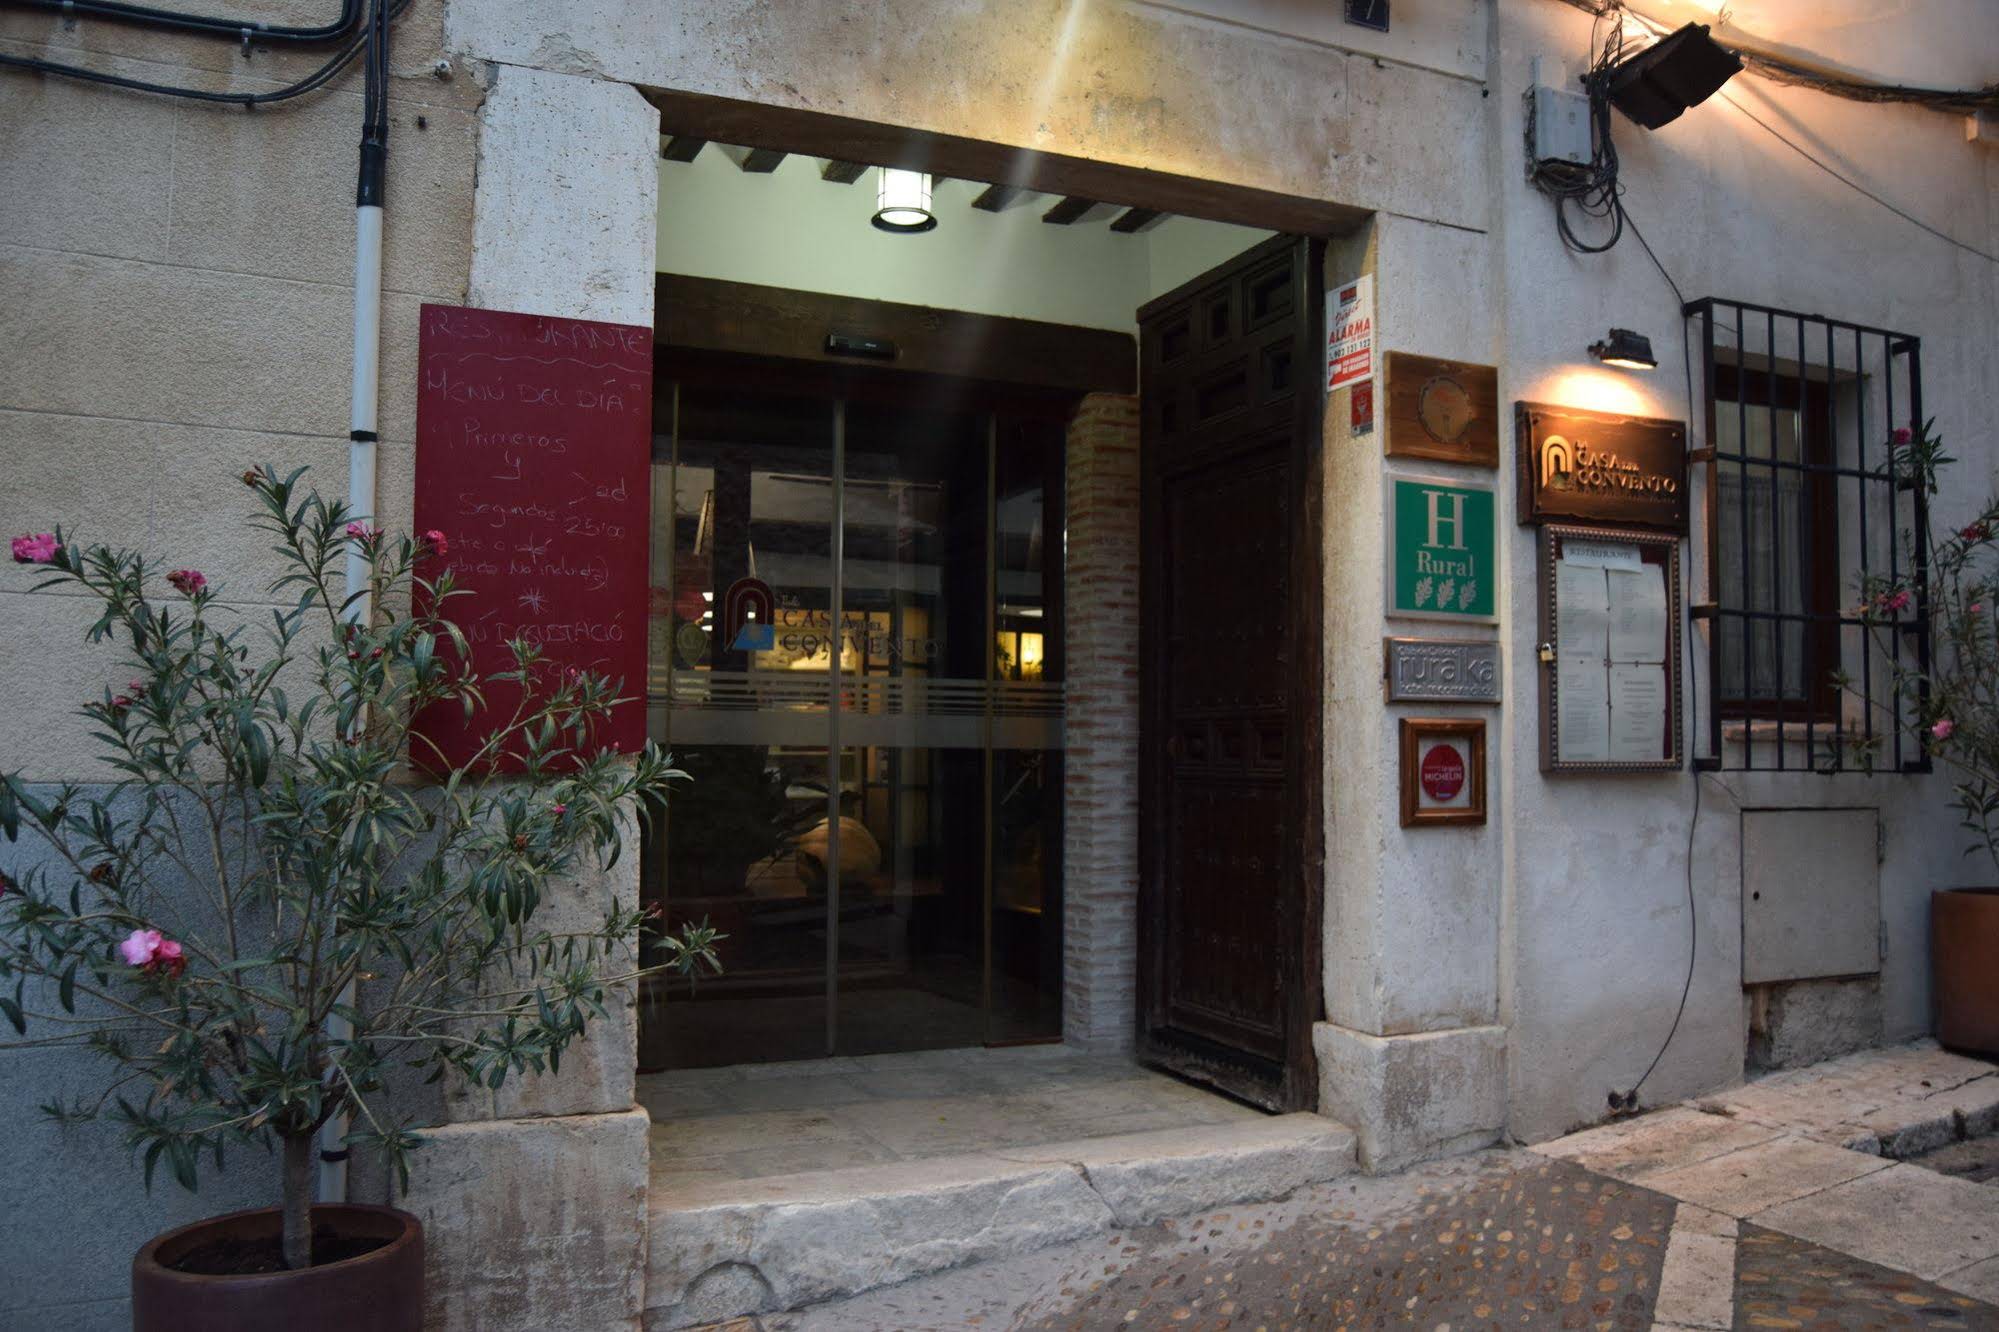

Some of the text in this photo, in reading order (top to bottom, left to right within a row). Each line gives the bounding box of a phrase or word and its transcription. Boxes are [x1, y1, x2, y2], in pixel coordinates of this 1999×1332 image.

[1328, 317, 1371, 345] ALARMA
[517, 383, 566, 406] DEL
[464, 416, 567, 456] Primeros
[1577, 451, 1621, 469] CASA
[1577, 470, 1677, 494] CONVENTO
[1422, 490, 1469, 550] H
[1416, 551, 1474, 577] Rural
[783, 609, 857, 630] CASA
[783, 634, 940, 659] CONVENTO
[1399, 648, 1494, 683] ruralka
[1424, 771, 1463, 783] MICHELIN
